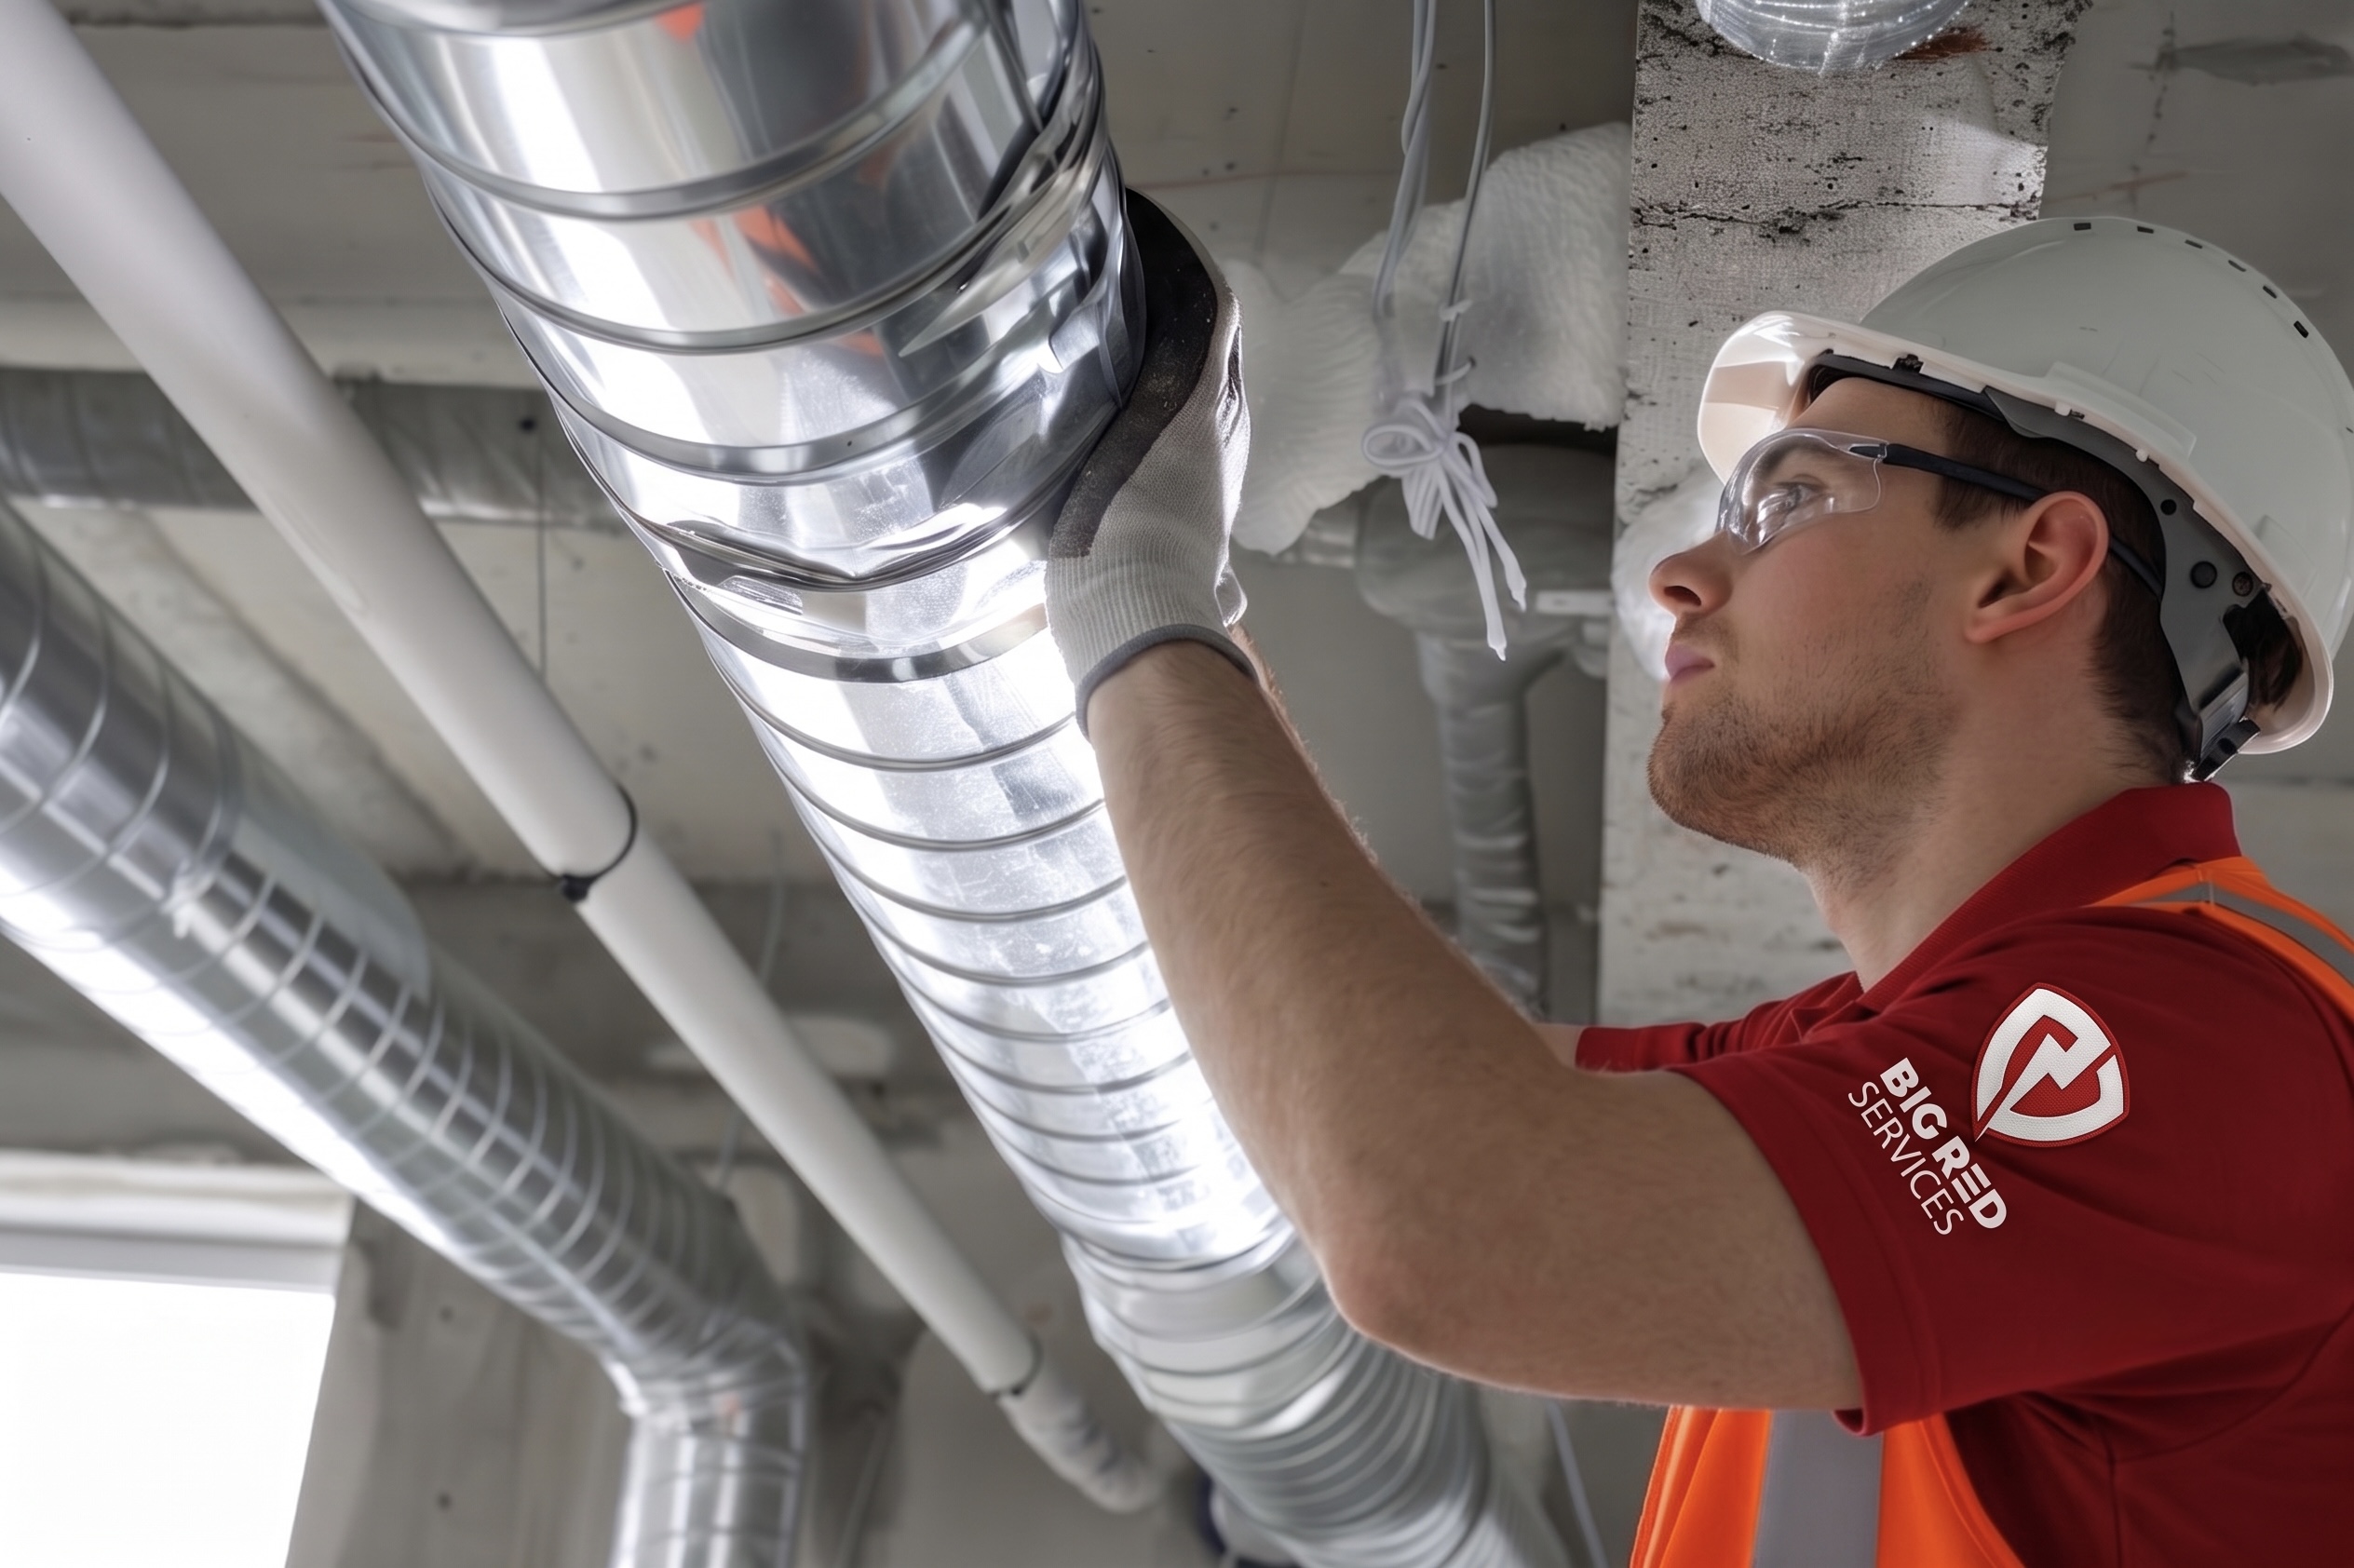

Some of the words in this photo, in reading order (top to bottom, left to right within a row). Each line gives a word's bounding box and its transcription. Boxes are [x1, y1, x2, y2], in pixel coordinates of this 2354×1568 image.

[1847, 1081, 1965, 1235] SERVICES
[1879, 1057, 1947, 1140] BIG
[1931, 1135, 2007, 1229] RED
